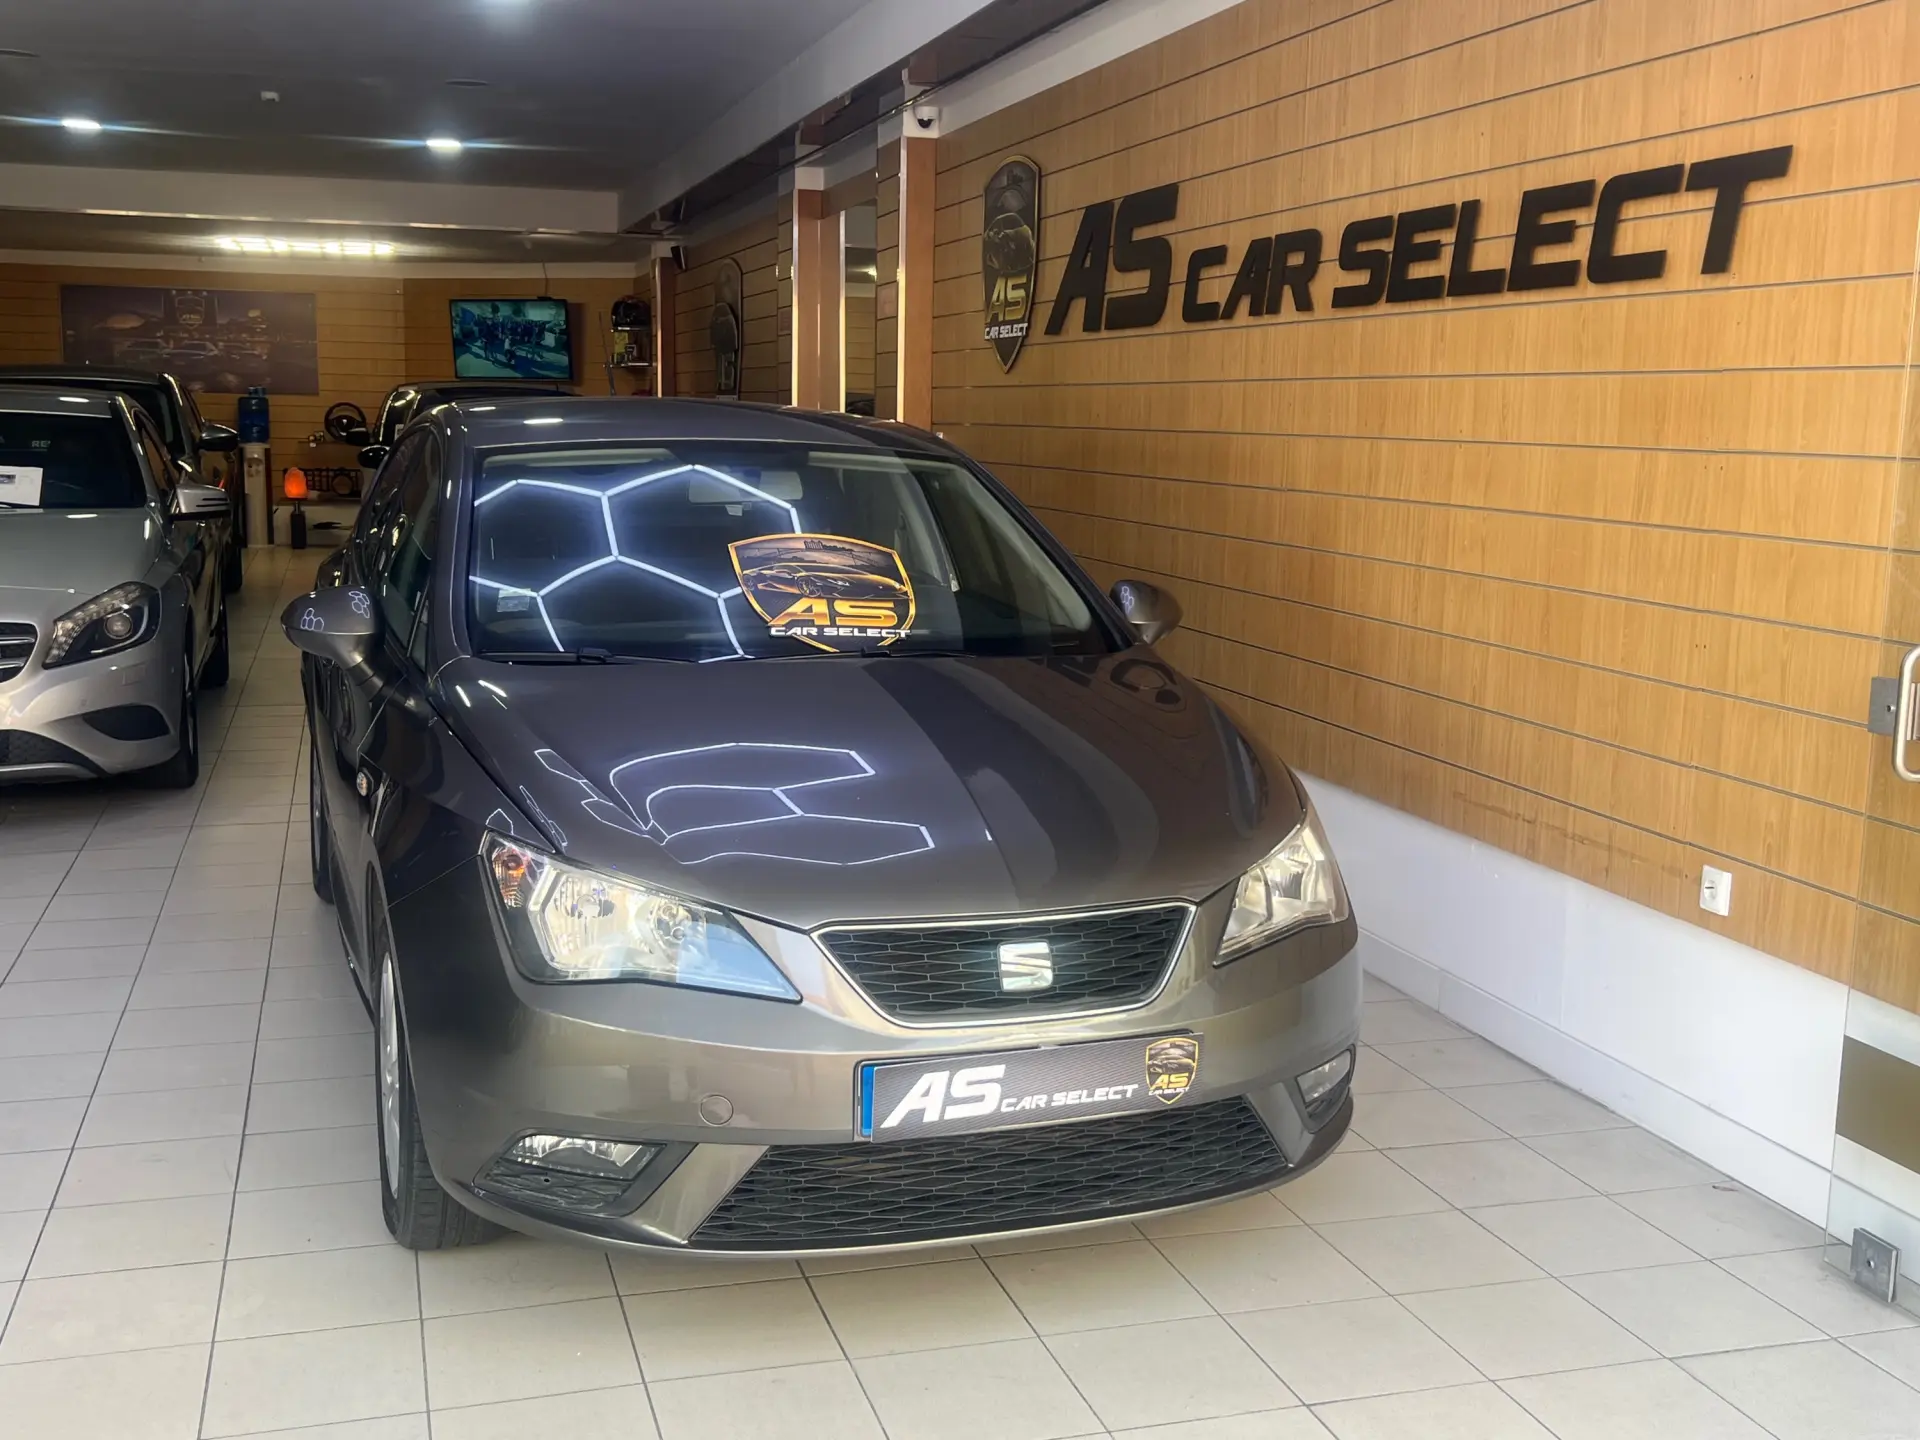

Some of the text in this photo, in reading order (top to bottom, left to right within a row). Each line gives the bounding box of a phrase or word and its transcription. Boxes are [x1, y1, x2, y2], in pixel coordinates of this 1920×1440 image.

[1044, 145, 1793, 336] AS CAR SELECT
[987, 275, 1027, 322] AS
[984, 322, 1028, 340] CAR SELECT
[768, 597, 898, 628] AS
[771, 627, 912, 639] CAR SELECT
[880, 1064, 1139, 1129] AS CAR SELECT
[1149, 1072, 1189, 1091] AS
